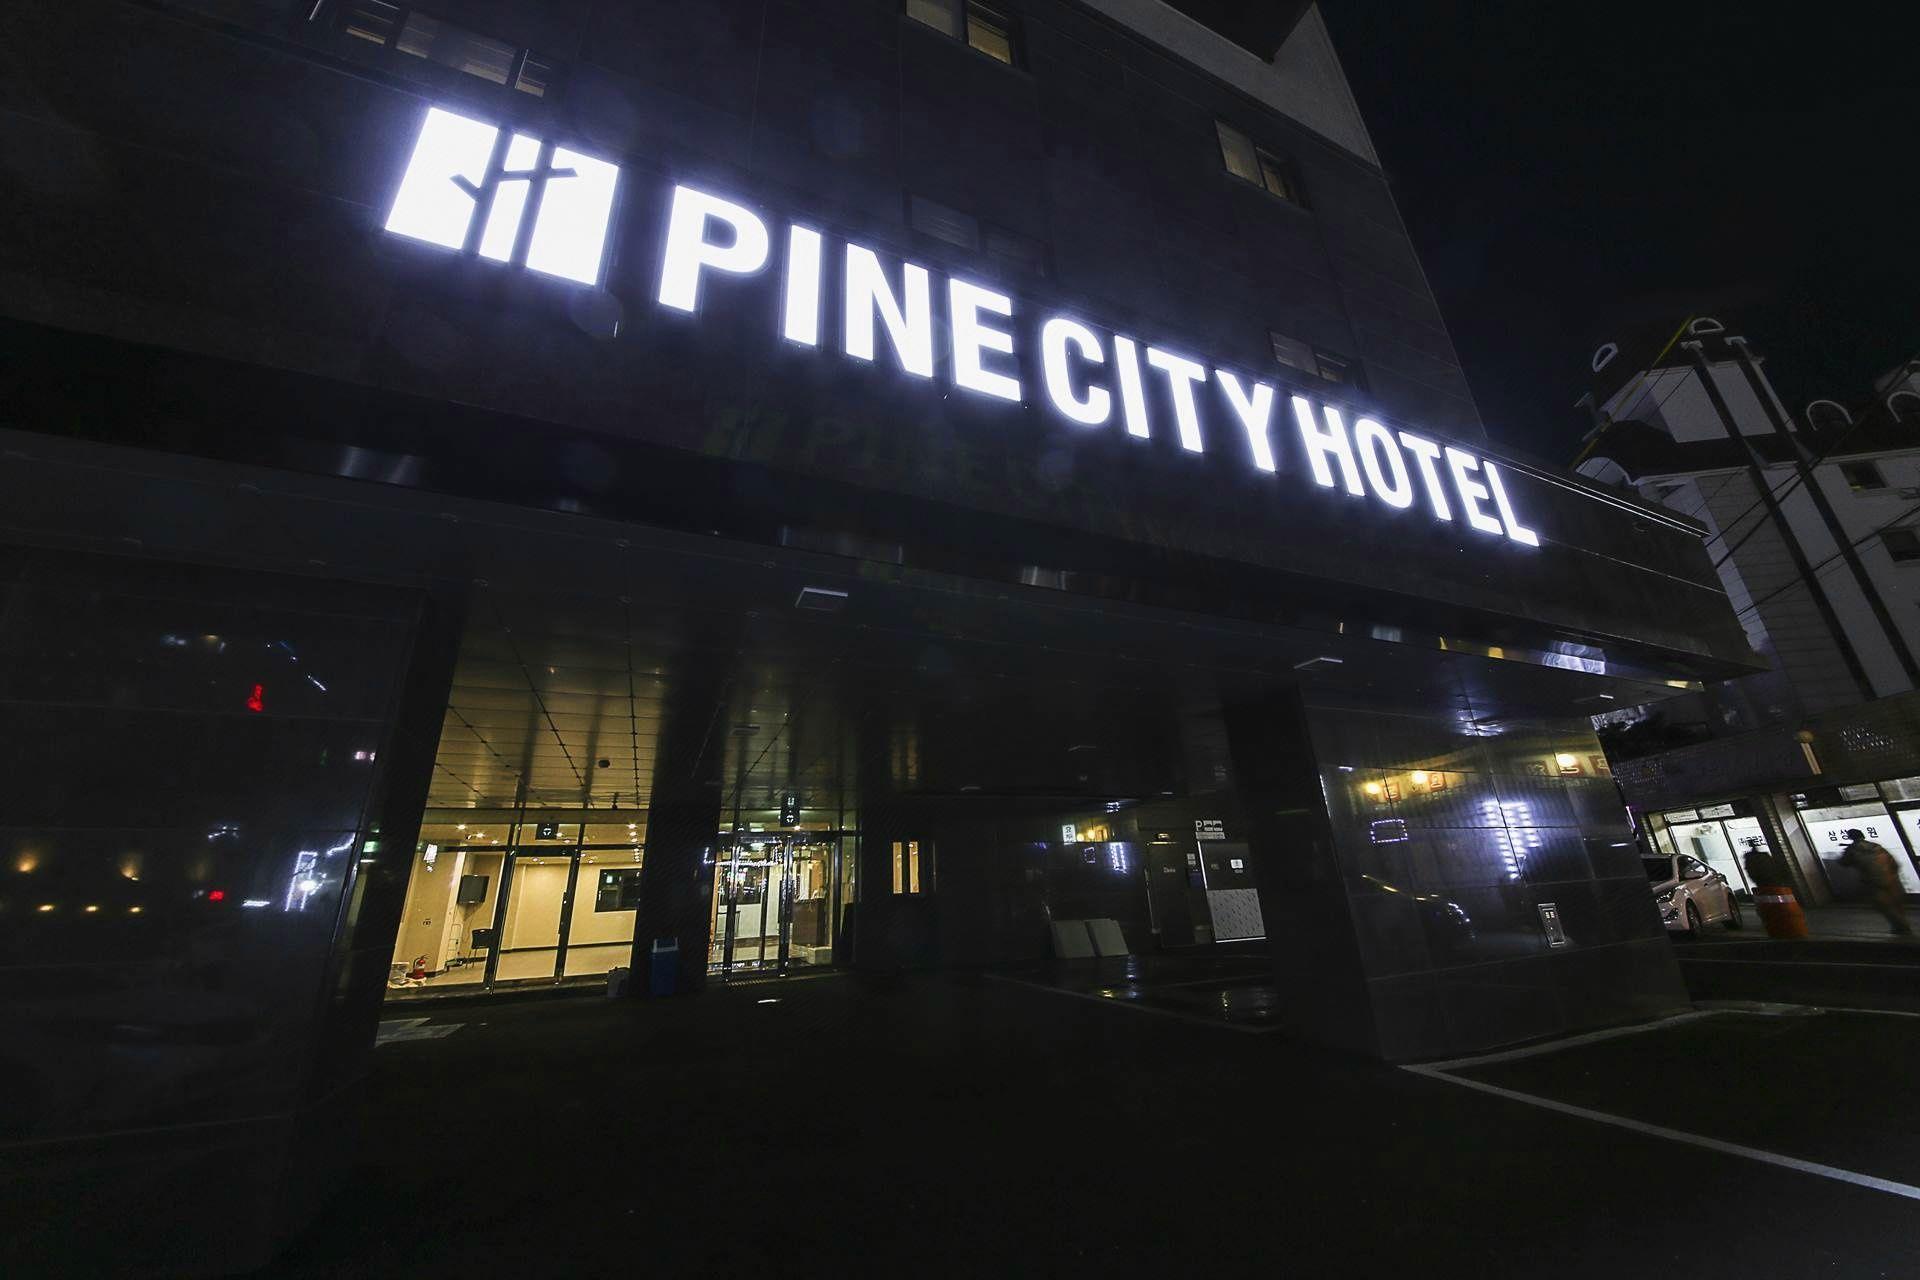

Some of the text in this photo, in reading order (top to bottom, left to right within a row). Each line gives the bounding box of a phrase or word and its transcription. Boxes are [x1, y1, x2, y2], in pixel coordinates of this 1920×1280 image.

[658, 185, 1540, 547] PINE CITY HOTEL
